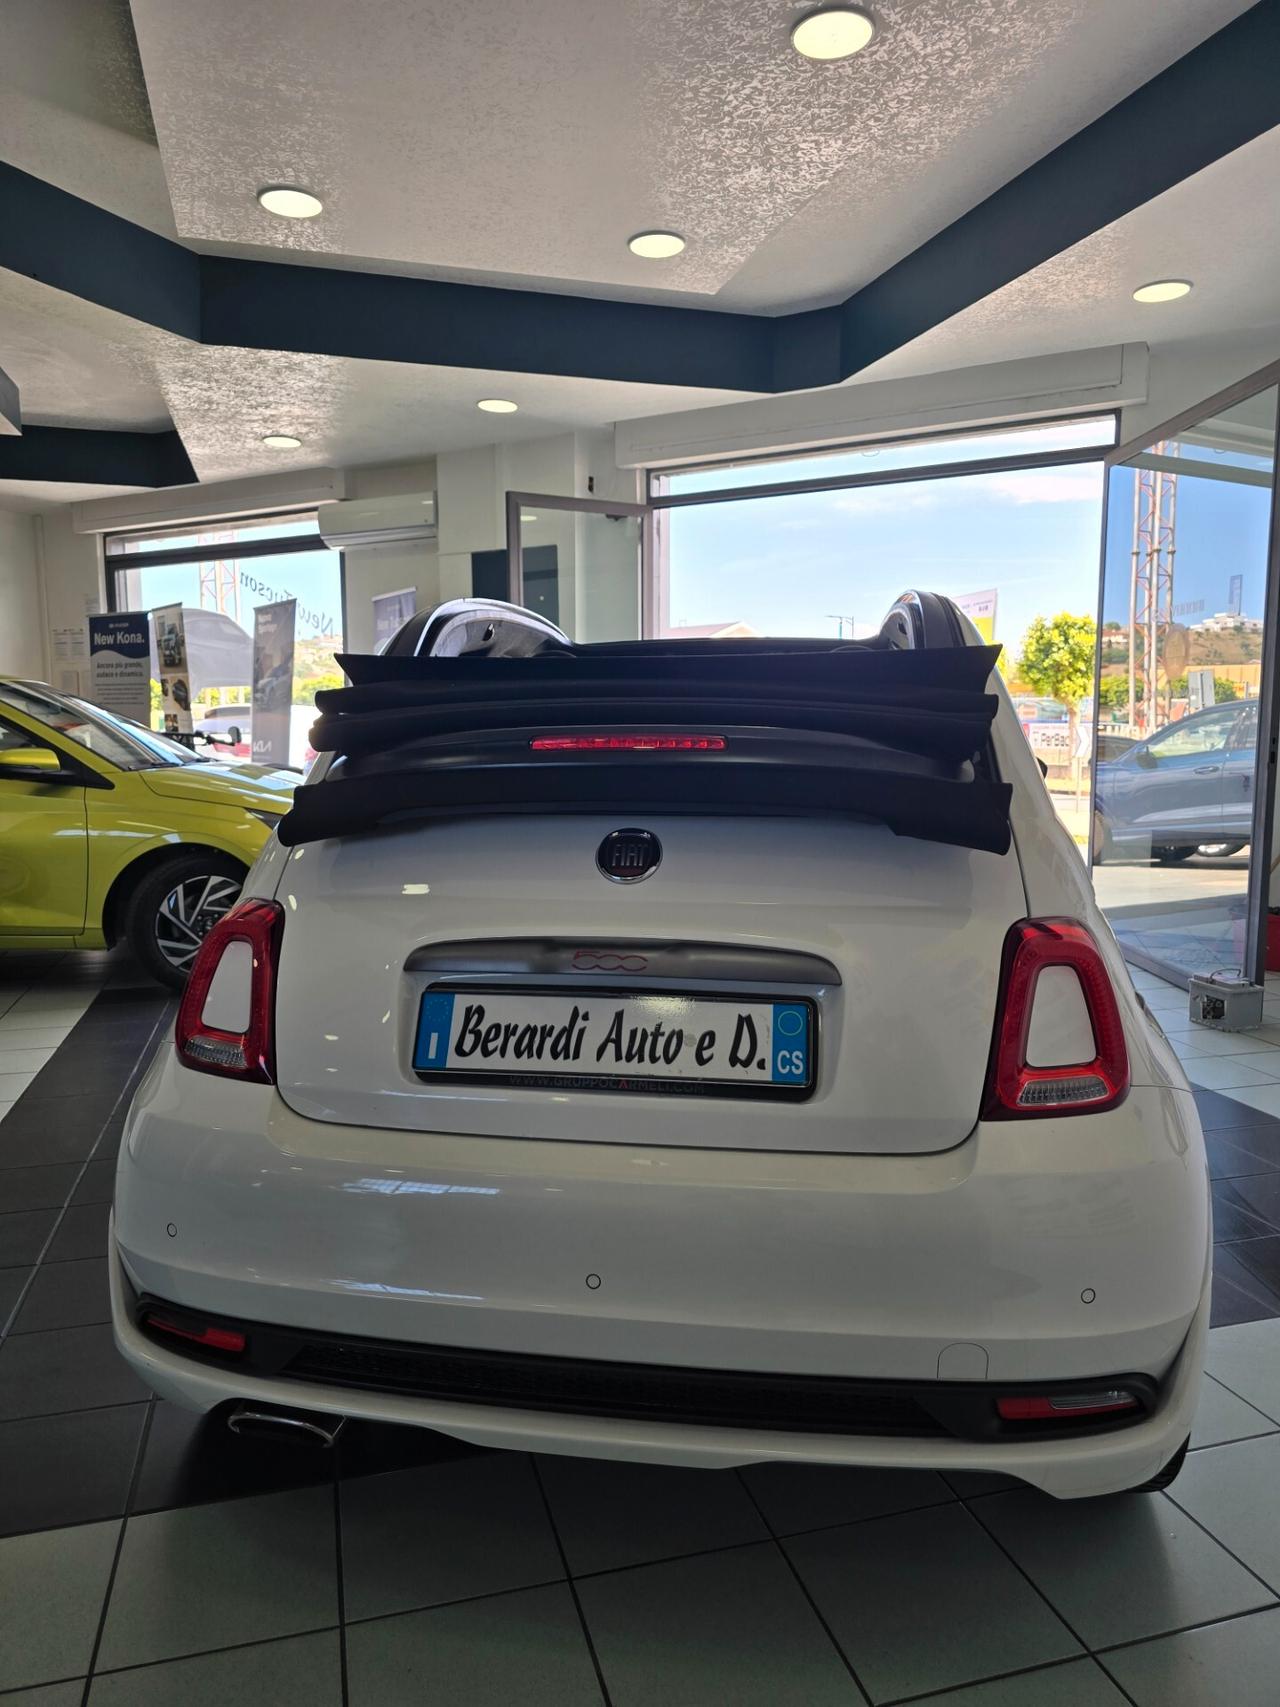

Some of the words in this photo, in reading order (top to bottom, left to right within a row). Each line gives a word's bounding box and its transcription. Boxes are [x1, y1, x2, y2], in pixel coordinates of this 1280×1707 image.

[93, 632, 115, 645] New
[116, 631, 145, 644] Kona.
[571, 950, 648, 972] 500
[454, 1004, 590, 1061] Berardi
[596, 1008, 684, 1065] Auto
[694, 1029, 716, 1067] e
[729, 1013, 767, 1071] D.
[777, 1049, 804, 1075] CS
